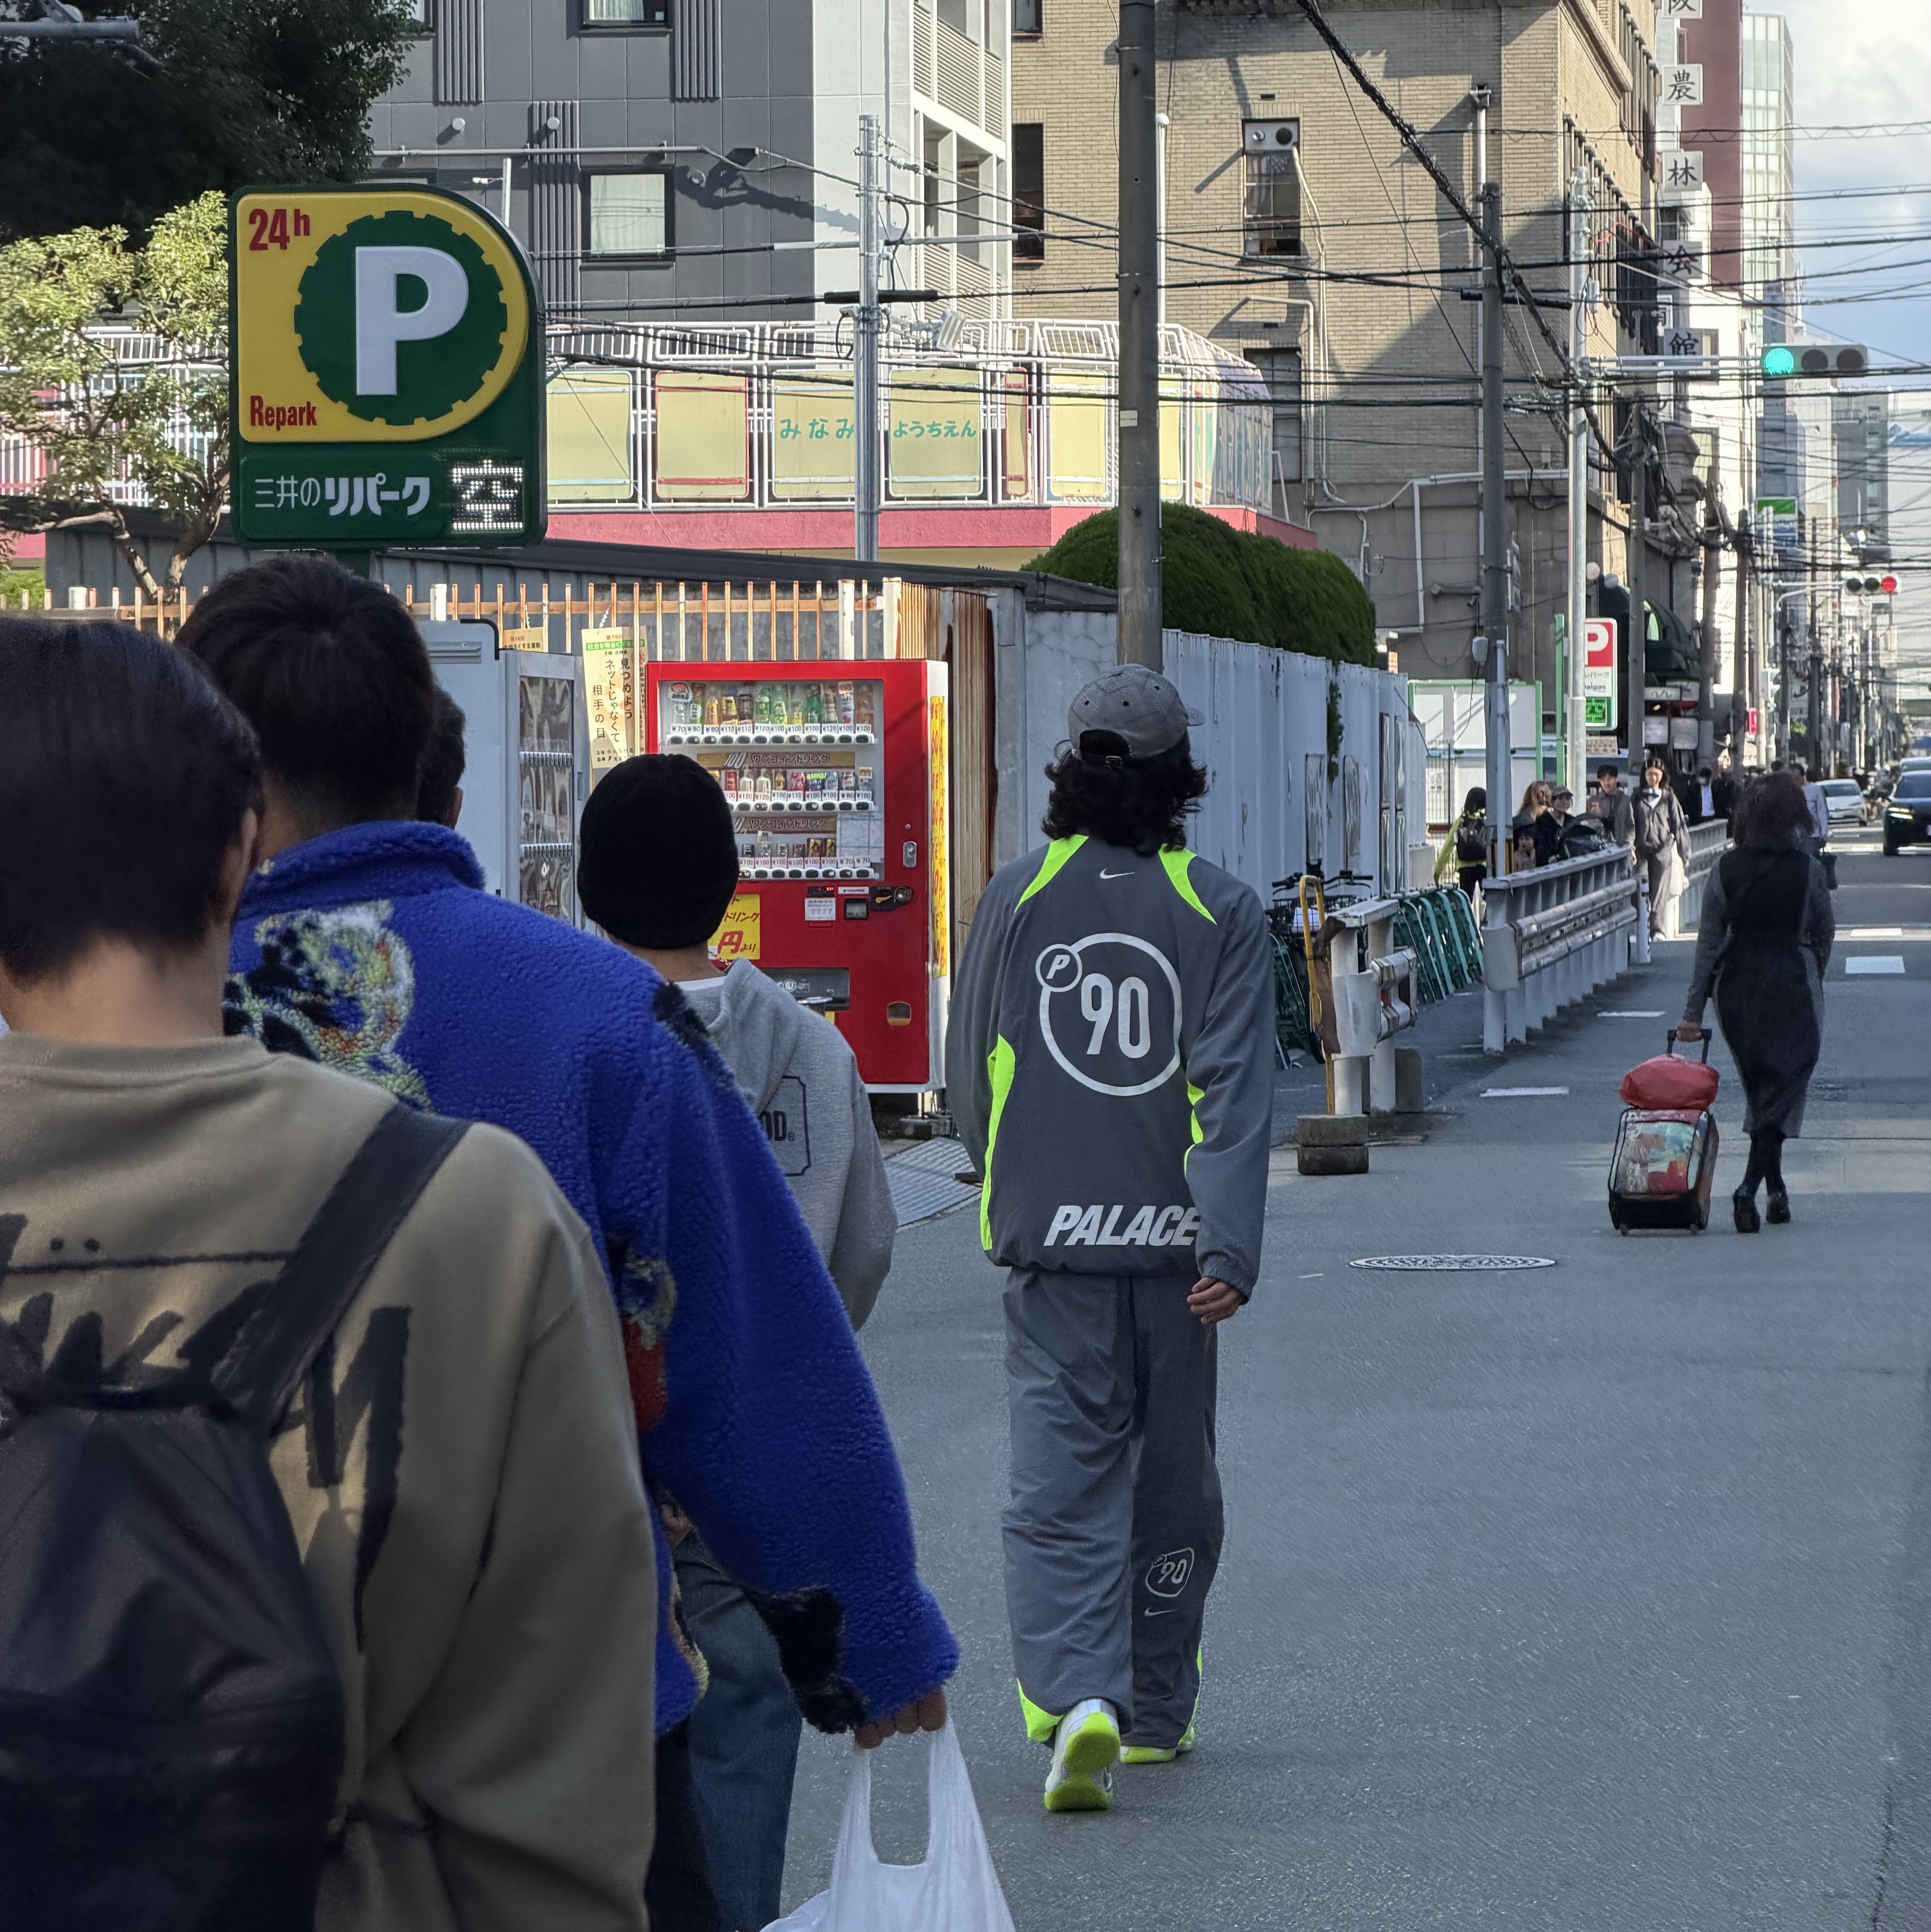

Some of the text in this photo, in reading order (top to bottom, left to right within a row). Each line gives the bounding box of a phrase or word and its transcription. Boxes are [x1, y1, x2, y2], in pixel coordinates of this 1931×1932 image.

[248, 208, 311, 251] 24h
[355, 246, 469, 396] P
[250, 395, 317, 431] Repark
[780, 418, 977, 440] みなみ ようちえん
[254, 473, 431, 516] 三井のリパーク
[1584, 624, 1609, 665] P
[605, 659, 620, 742] ネットじゃなくて
[620, 658, 633, 720] 見つめよう
[592, 684, 605, 739] 相手の目
[724, 912, 759, 922] ドリンク
[1046, 954, 1071, 979] P
[1080, 972, 1151, 1059] 90
[1043, 1204, 1202, 1248] PALACE
[1157, 1558, 1187, 1584] 90
